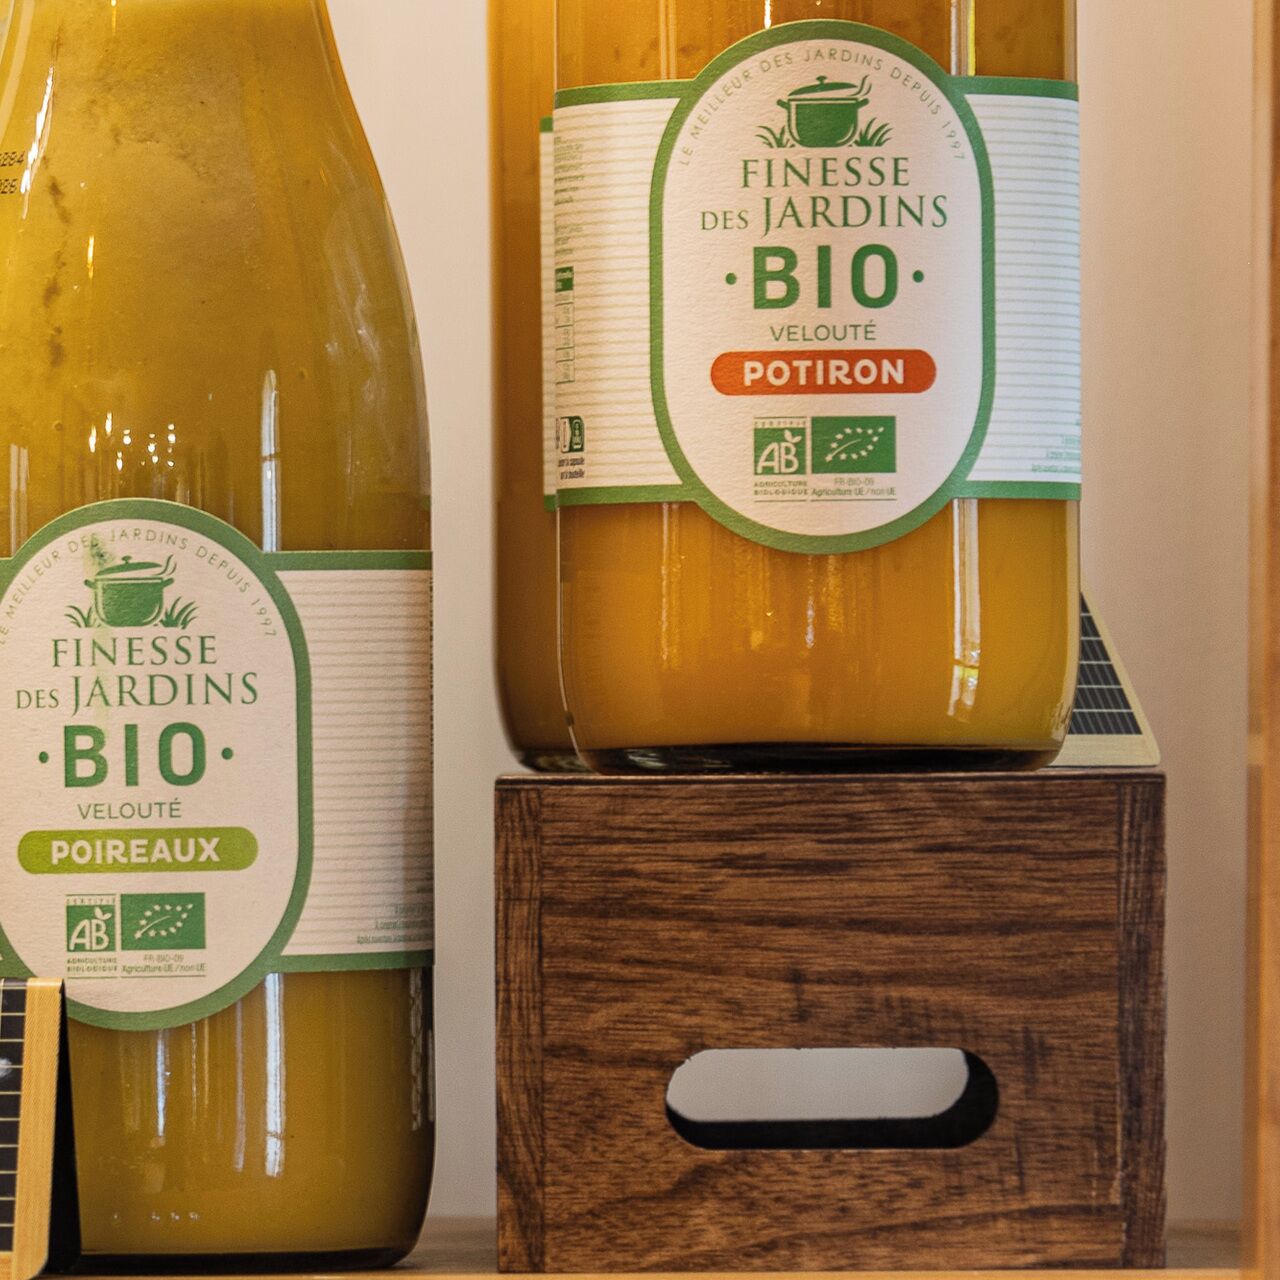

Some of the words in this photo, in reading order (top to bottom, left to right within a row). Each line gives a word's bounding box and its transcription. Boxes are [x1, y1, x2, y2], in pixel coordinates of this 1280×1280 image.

[760, 51, 793, 72] DES
[804, 48, 882, 71] JARDINS
[890, 66, 941, 116] DEPUIS
[742, 157, 910, 188] FINESSE
[701, 210, 748, 230] DES
[761, 195, 948, 237] JARDINS
[753, 244, 897, 309] BIO
[770, 321, 877, 342] VELOUTÉ
[744, 359, 904, 386] POTIRON
[757, 442, 798, 474] AB
[68, 535, 103, 554] DES
[110, 528, 189, 551] JARDINS
[195, 546, 251, 593] DEPUIS
[52, 635, 218, 668] FINESSE
[17, 689, 60, 710] DES
[71, 672, 258, 716] JARDINS
[64, 722, 206, 788] BIO
[78, 798, 181, 820] VELOUTÉ
[51, 837, 220, 865] POIREAUX
[69, 919, 109, 950] AB
